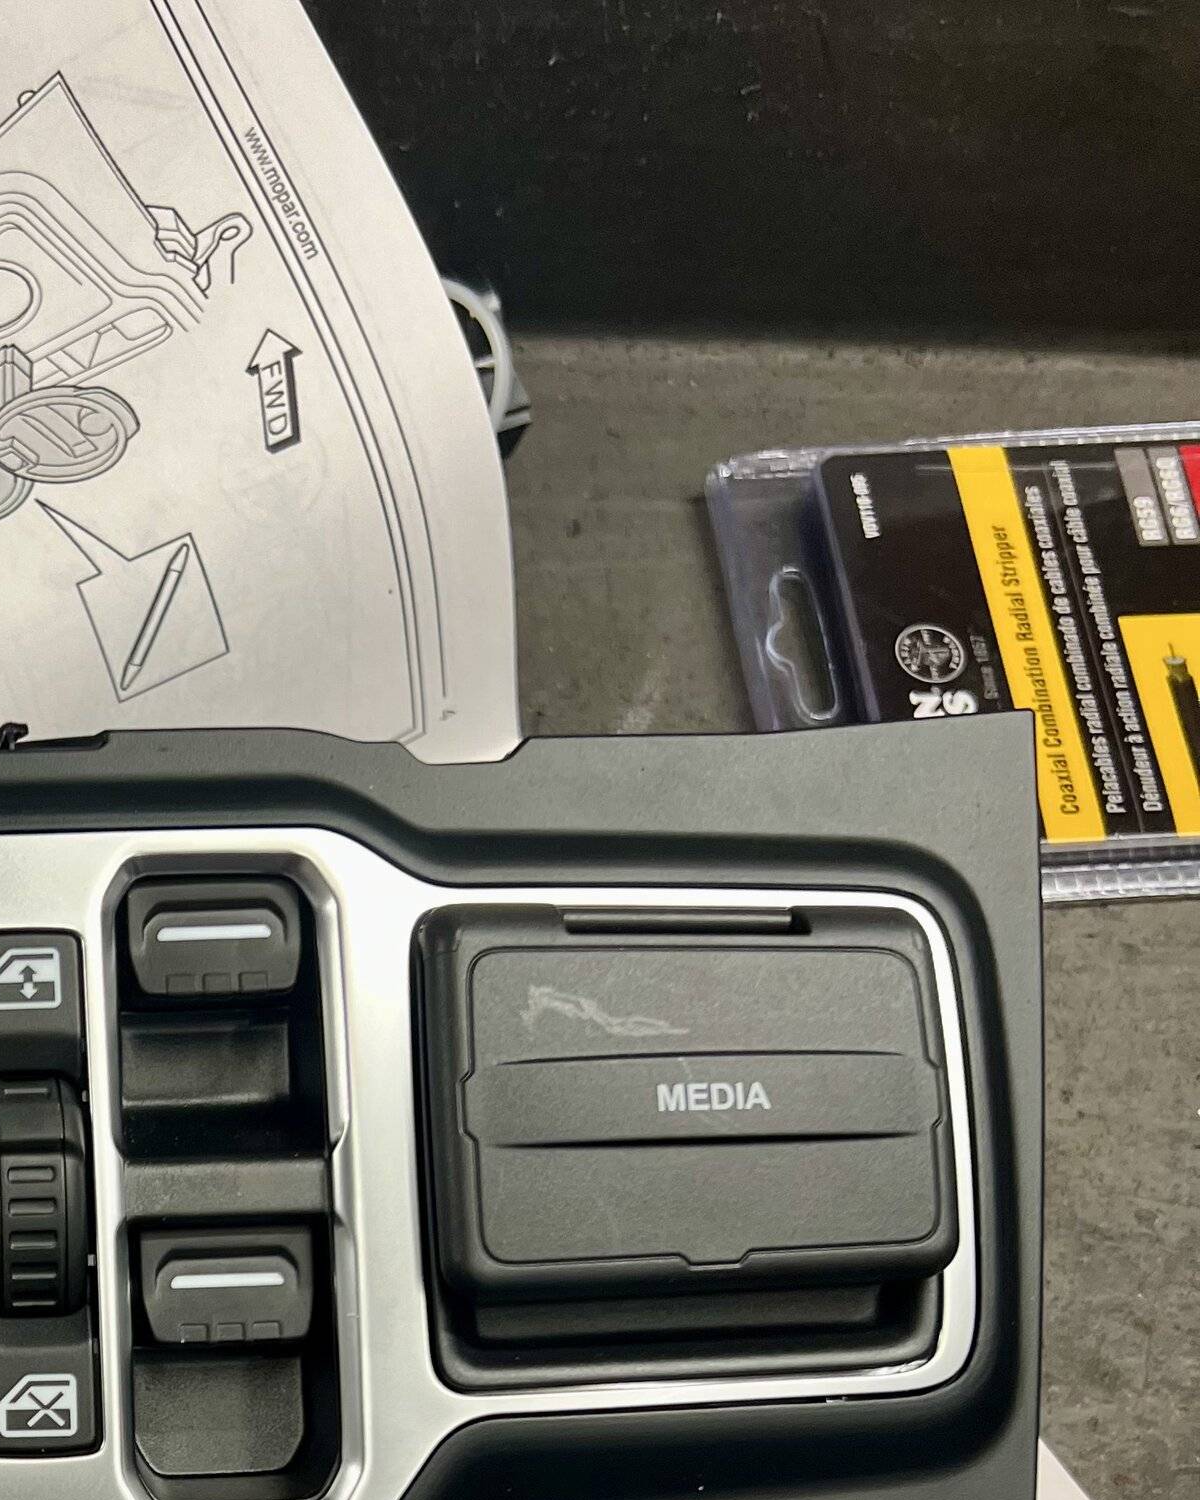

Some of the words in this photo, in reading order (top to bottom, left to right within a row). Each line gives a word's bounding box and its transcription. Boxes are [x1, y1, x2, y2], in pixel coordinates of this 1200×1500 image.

[243, 126, 319, 260] www.mopar.com
[259, 360, 289, 436] FWD
[992, 525, 1020, 588] Stripper
[1041, 550, 1067, 595] cables
[1075, 543, 1102, 575] pour
[1005, 592, 1034, 641] Radial
[1052, 596, 1071, 614] de
[1057, 615, 1093, 691] combinado
[1100, 641, 1129, 689] radiale
[1023, 647, 1062, 748] Combination
[1075, 693, 1104, 734] radial
[1115, 690, 1141, 732] action
[1046, 753, 1080, 815] Coaxial
[1091, 735, 1127, 814] Pelacables
[656, 1081, 772, 1113] MEDIA
